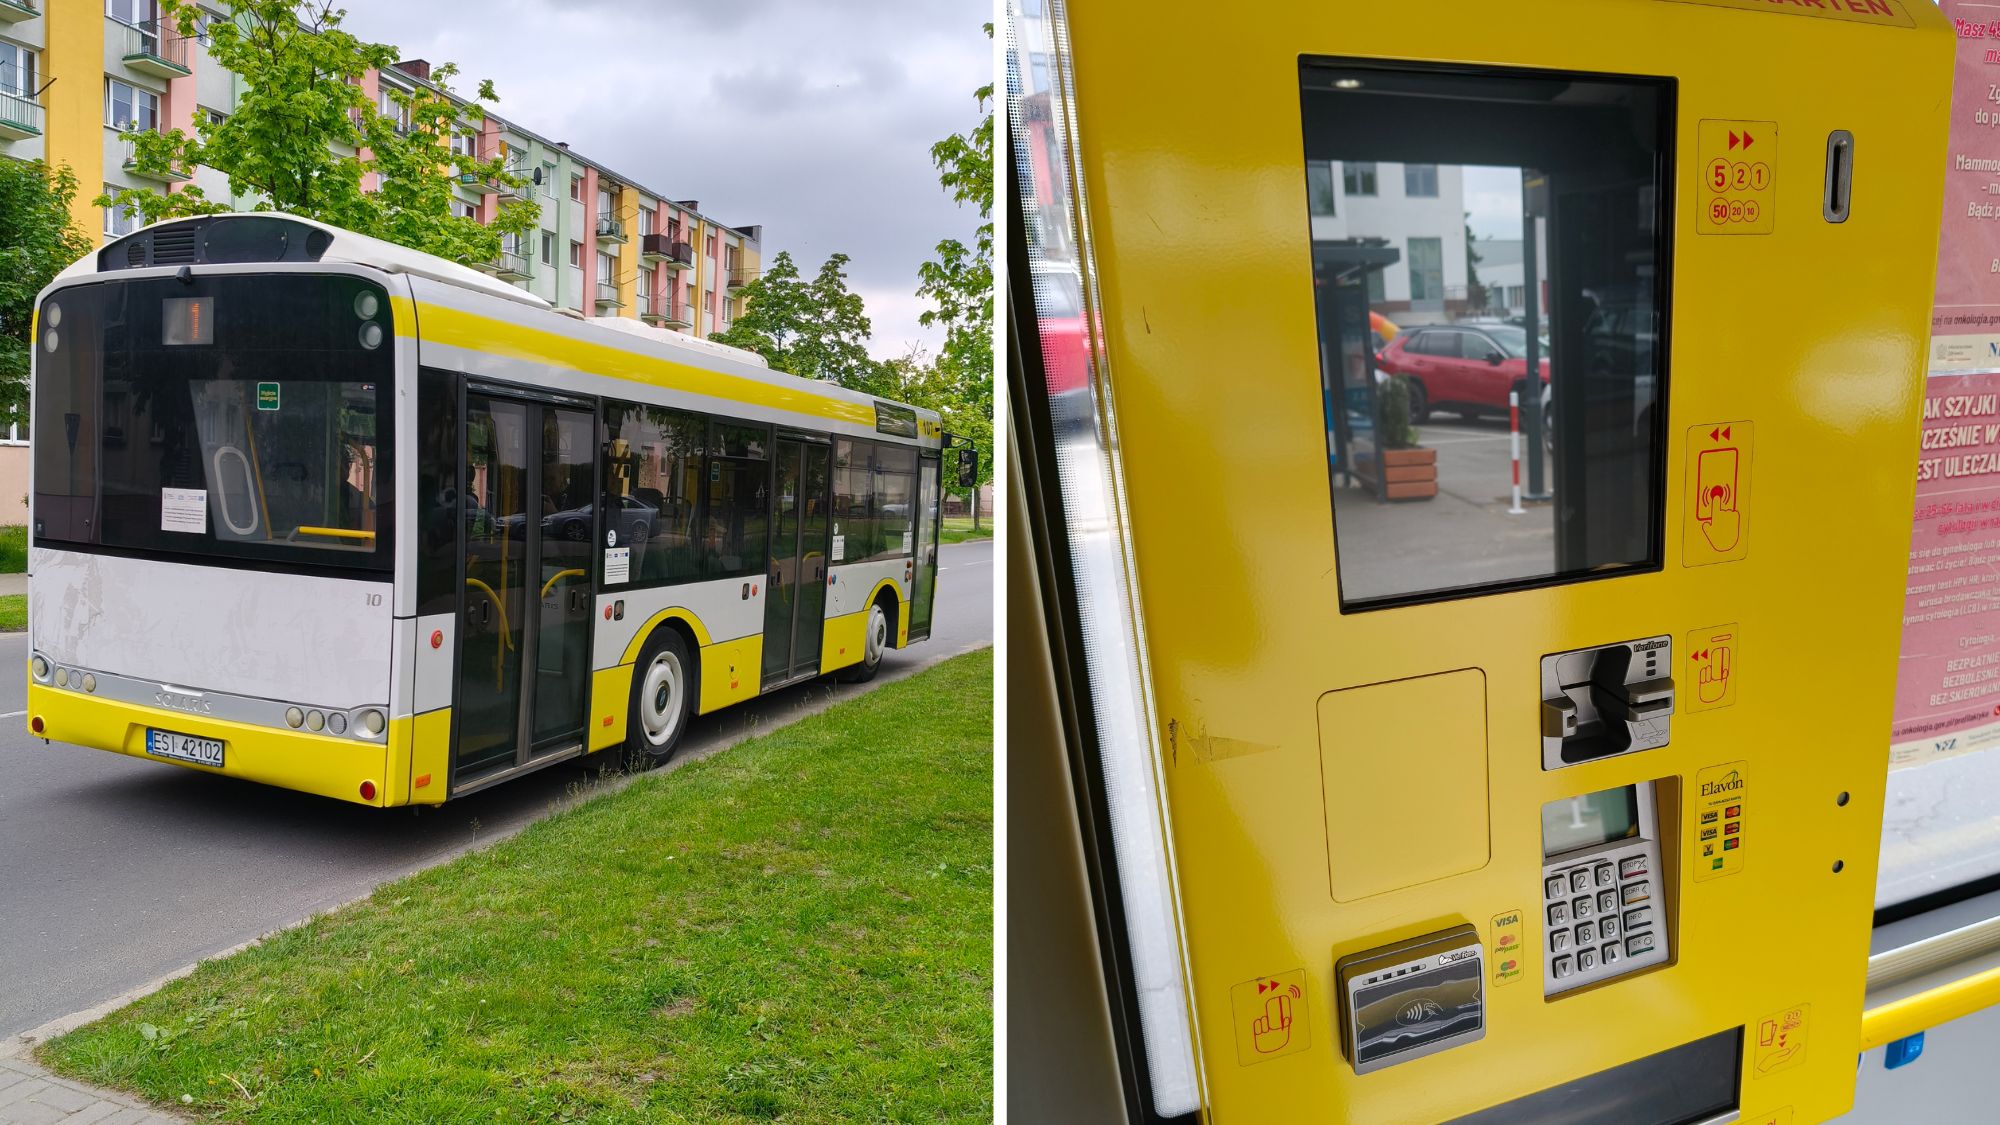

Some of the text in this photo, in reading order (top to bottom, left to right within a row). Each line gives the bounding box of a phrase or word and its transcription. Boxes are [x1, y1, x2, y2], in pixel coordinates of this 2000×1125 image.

[1955, 17, 1985, 38] Masz
[1975, 107, 1988, 124] do
[1715, 165, 1762, 187] 5 2 1
[1713, 204, 1755, 218] 50 20 10
[1923, 393, 1997, 420] AK SZYJKI
[1920, 422, 2000, 450] CZEŚNIE W
[1917, 458, 1942, 480] EST
[366, 593, 382, 606] 10
[154, 692, 212, 714] SOLARIS
[1929, 692, 1948, 706] BEZ
[153, 732, 175, 753] ESI
[181, 738, 221, 761] 42102
[1701, 779, 1743, 796] Elavon
[1703, 812, 1718, 821] VISA
[1703, 828, 1717, 838] VISA
[1553, 869, 1611, 895] 1 2 3
[1556, 895, 1613, 921] 4 5 6
[1628, 912, 1642, 921] INFO
[1494, 915, 1519, 927] VISA
[1559, 921, 1615, 948] 7 8 9
[1585, 954, 1593, 968] 0
